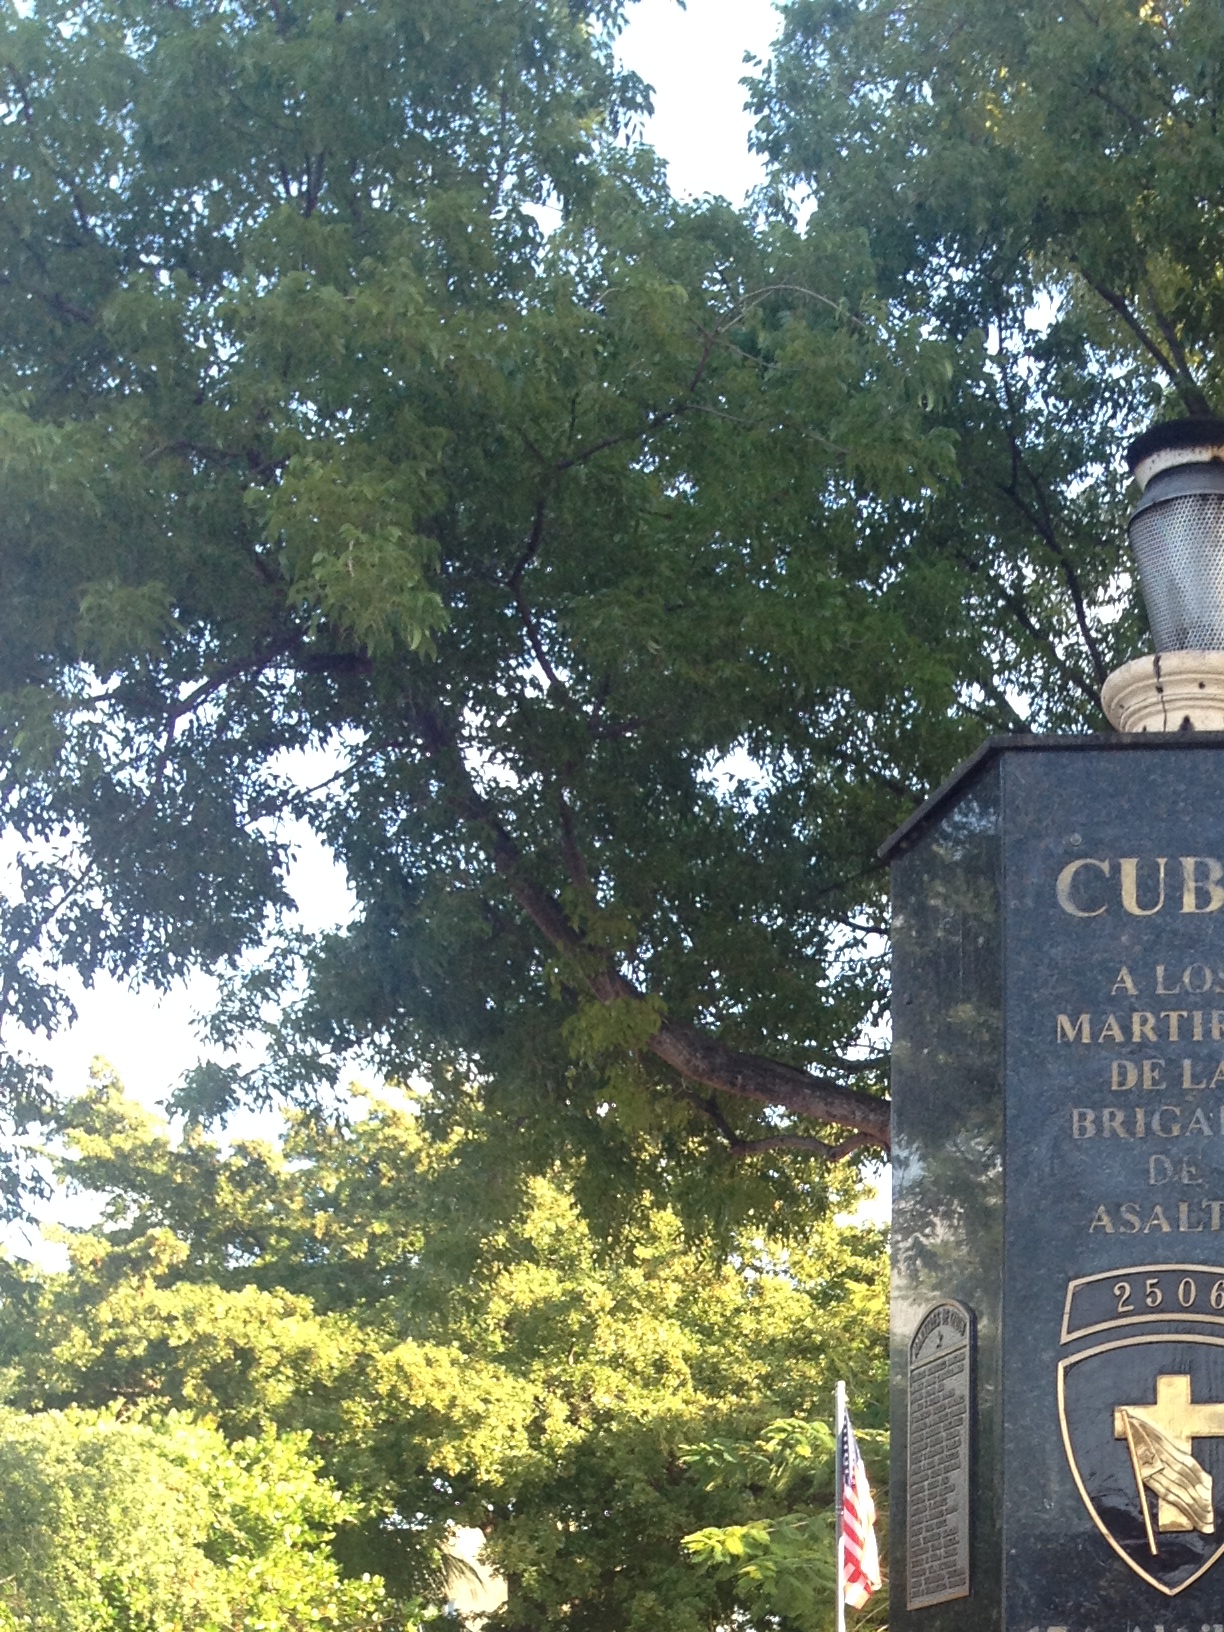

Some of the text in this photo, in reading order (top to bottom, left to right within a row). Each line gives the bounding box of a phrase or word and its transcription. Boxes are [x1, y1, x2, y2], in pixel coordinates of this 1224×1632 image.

[1110, 965, 1139, 996] A
[1110, 1059, 1167, 1091] DE
[1148, 1153, 1203, 1186] DE
